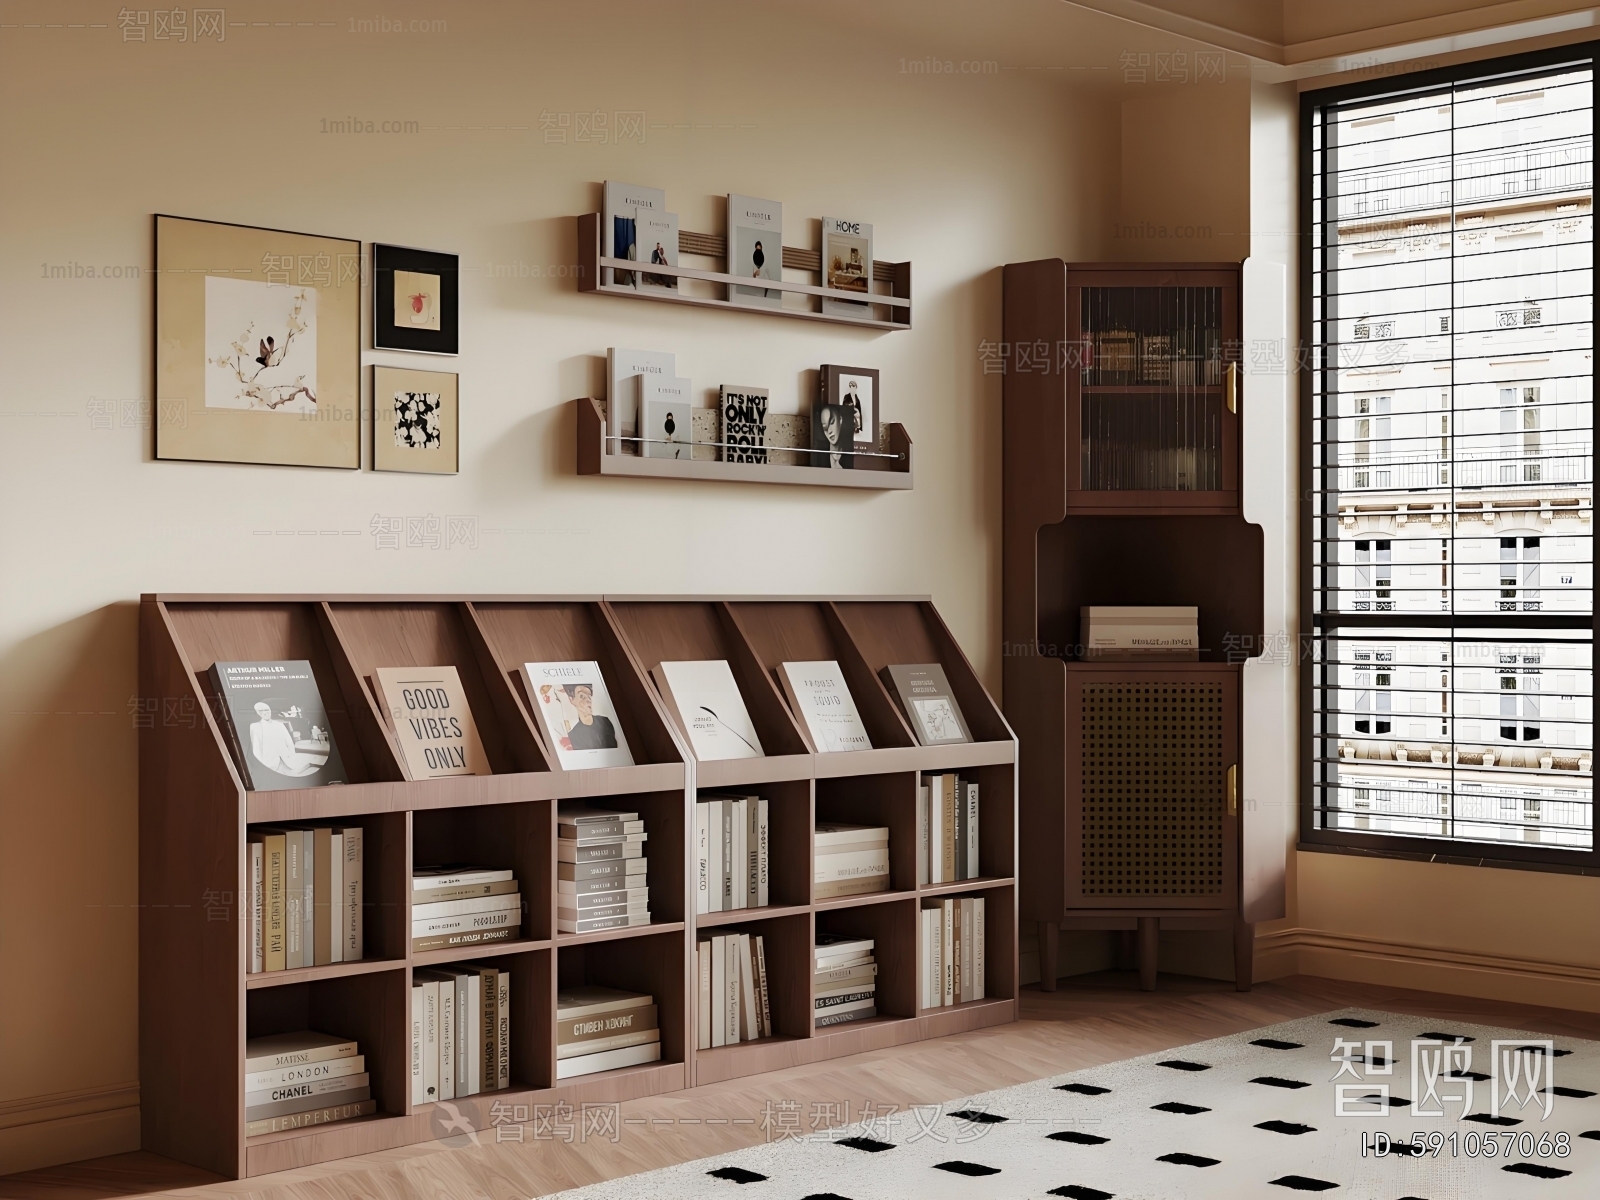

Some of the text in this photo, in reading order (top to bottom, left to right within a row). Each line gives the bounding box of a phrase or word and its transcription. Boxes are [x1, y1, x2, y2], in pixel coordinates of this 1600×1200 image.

[836, 220, 860, 234] HOME
[727, 393, 768, 408] IT'S NOT
[725, 405, 767, 425] ONLY
[727, 434, 768, 456] ROLL
[402, 688, 450, 710] GOOD
[408, 716, 463, 740] VIBES
[424, 746, 467, 770] ONLY
[573, 1020, 604, 1036] СТИВЕН
[281, 1066, 329, 1082] LONDON
[271, 1085, 314, 1101] CHANEL
